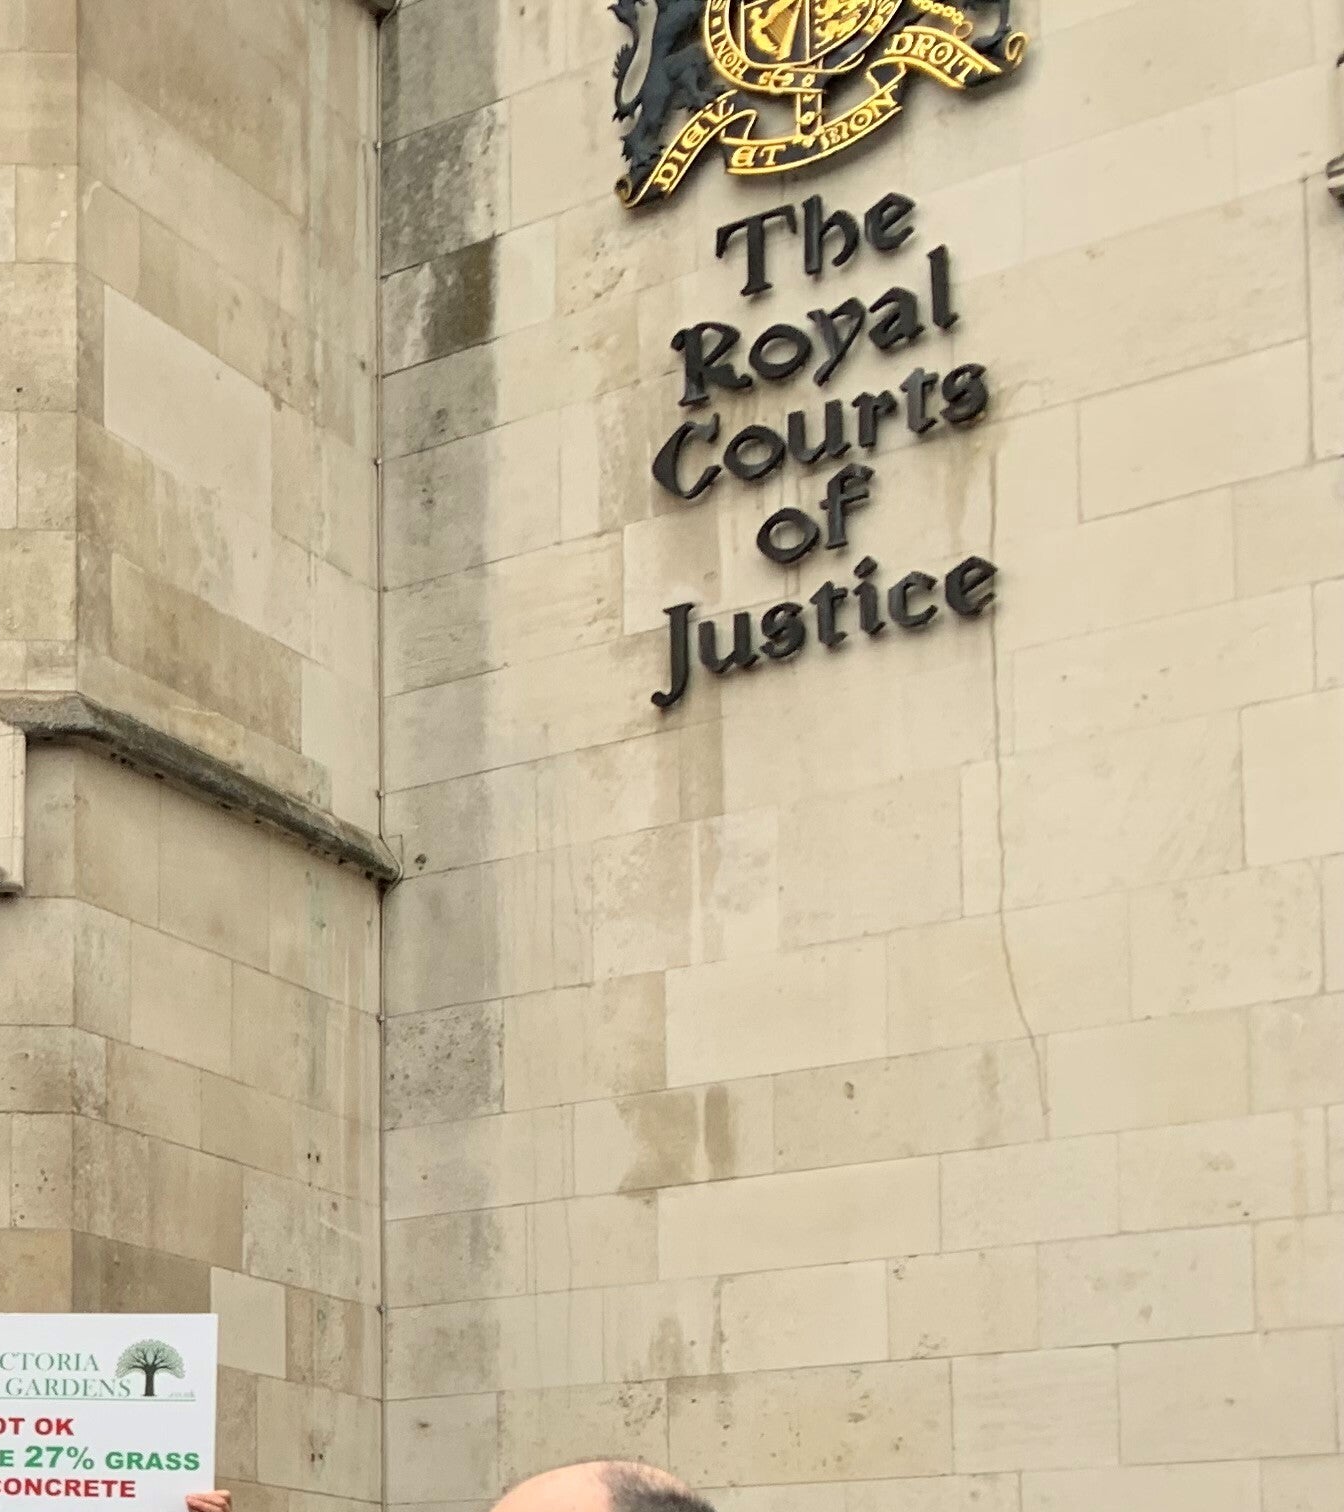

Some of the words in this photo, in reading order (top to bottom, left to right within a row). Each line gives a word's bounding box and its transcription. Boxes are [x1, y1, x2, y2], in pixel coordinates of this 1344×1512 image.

[884, 30, 984, 85] DROIT
[730, 144, 787, 168] ET
[713, 188, 920, 300] The
[668, 243, 959, 410] Royal
[650, 361, 991, 502] Courts
[755, 461, 876, 566] of
[650, 554, 999, 711] Justice
[5, 1375, 131, 1400] GARDENS
[34, 1417, 75, 1436] OK
[24, 1445, 95, 1471] 27%
[104, 1451, 201, 1472] GRASS
